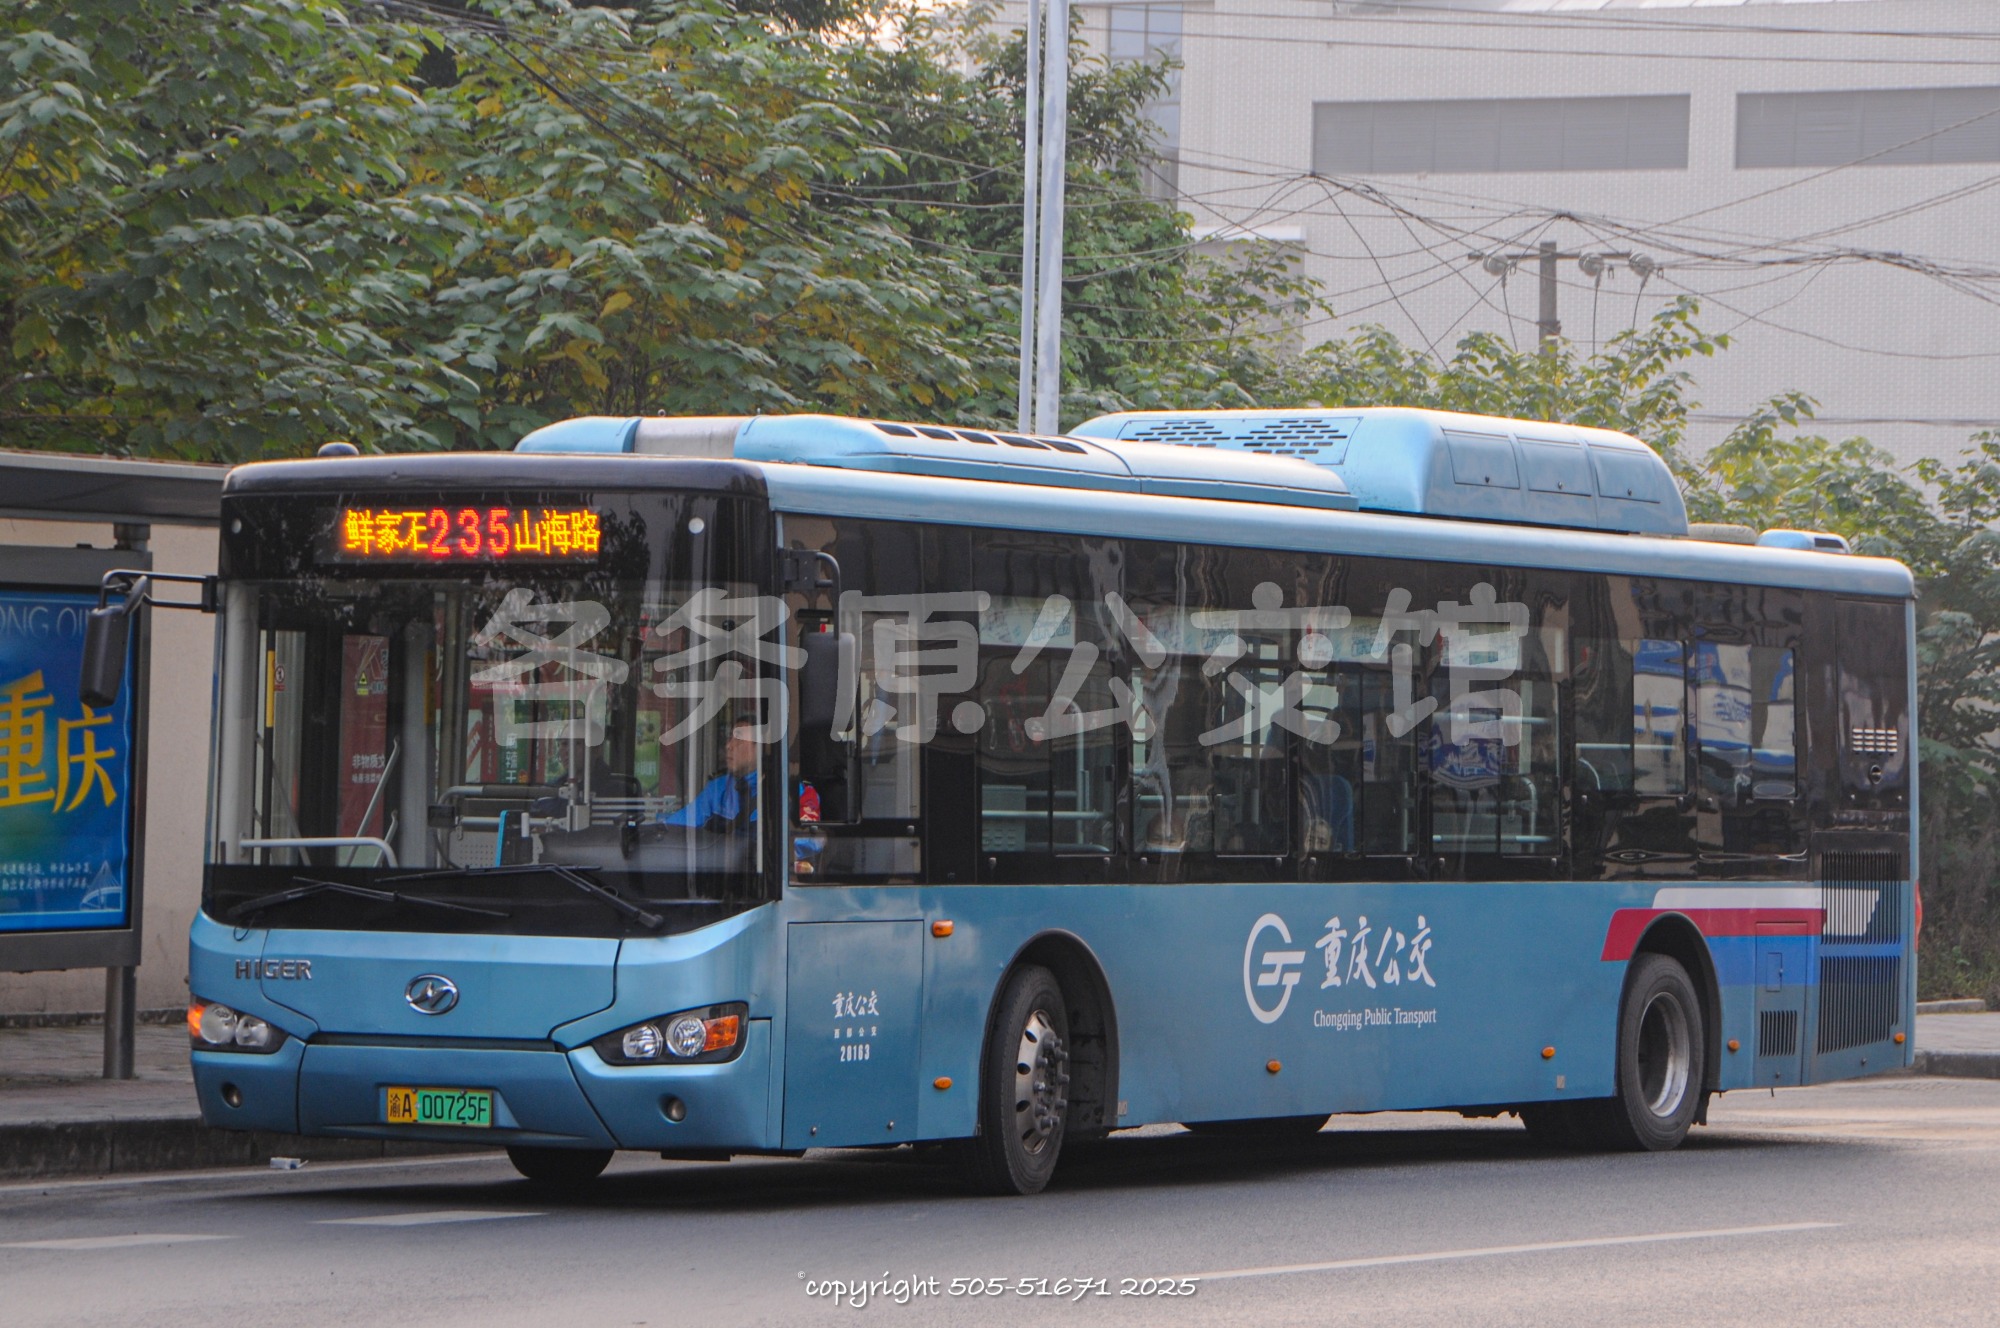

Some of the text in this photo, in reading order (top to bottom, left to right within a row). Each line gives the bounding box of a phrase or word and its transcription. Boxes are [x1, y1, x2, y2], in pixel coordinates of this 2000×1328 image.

[429, 508, 510, 555] 235
[515, 509, 600, 554] 山海路
[0, 669, 117, 813] 重庆
[235, 960, 312, 980] HIGER
[1315, 915, 1436, 989] 重庆公交
[832, 990, 879, 1018] 重庆公交
[1314, 1007, 1436, 1031] Chongqing Public Transport
